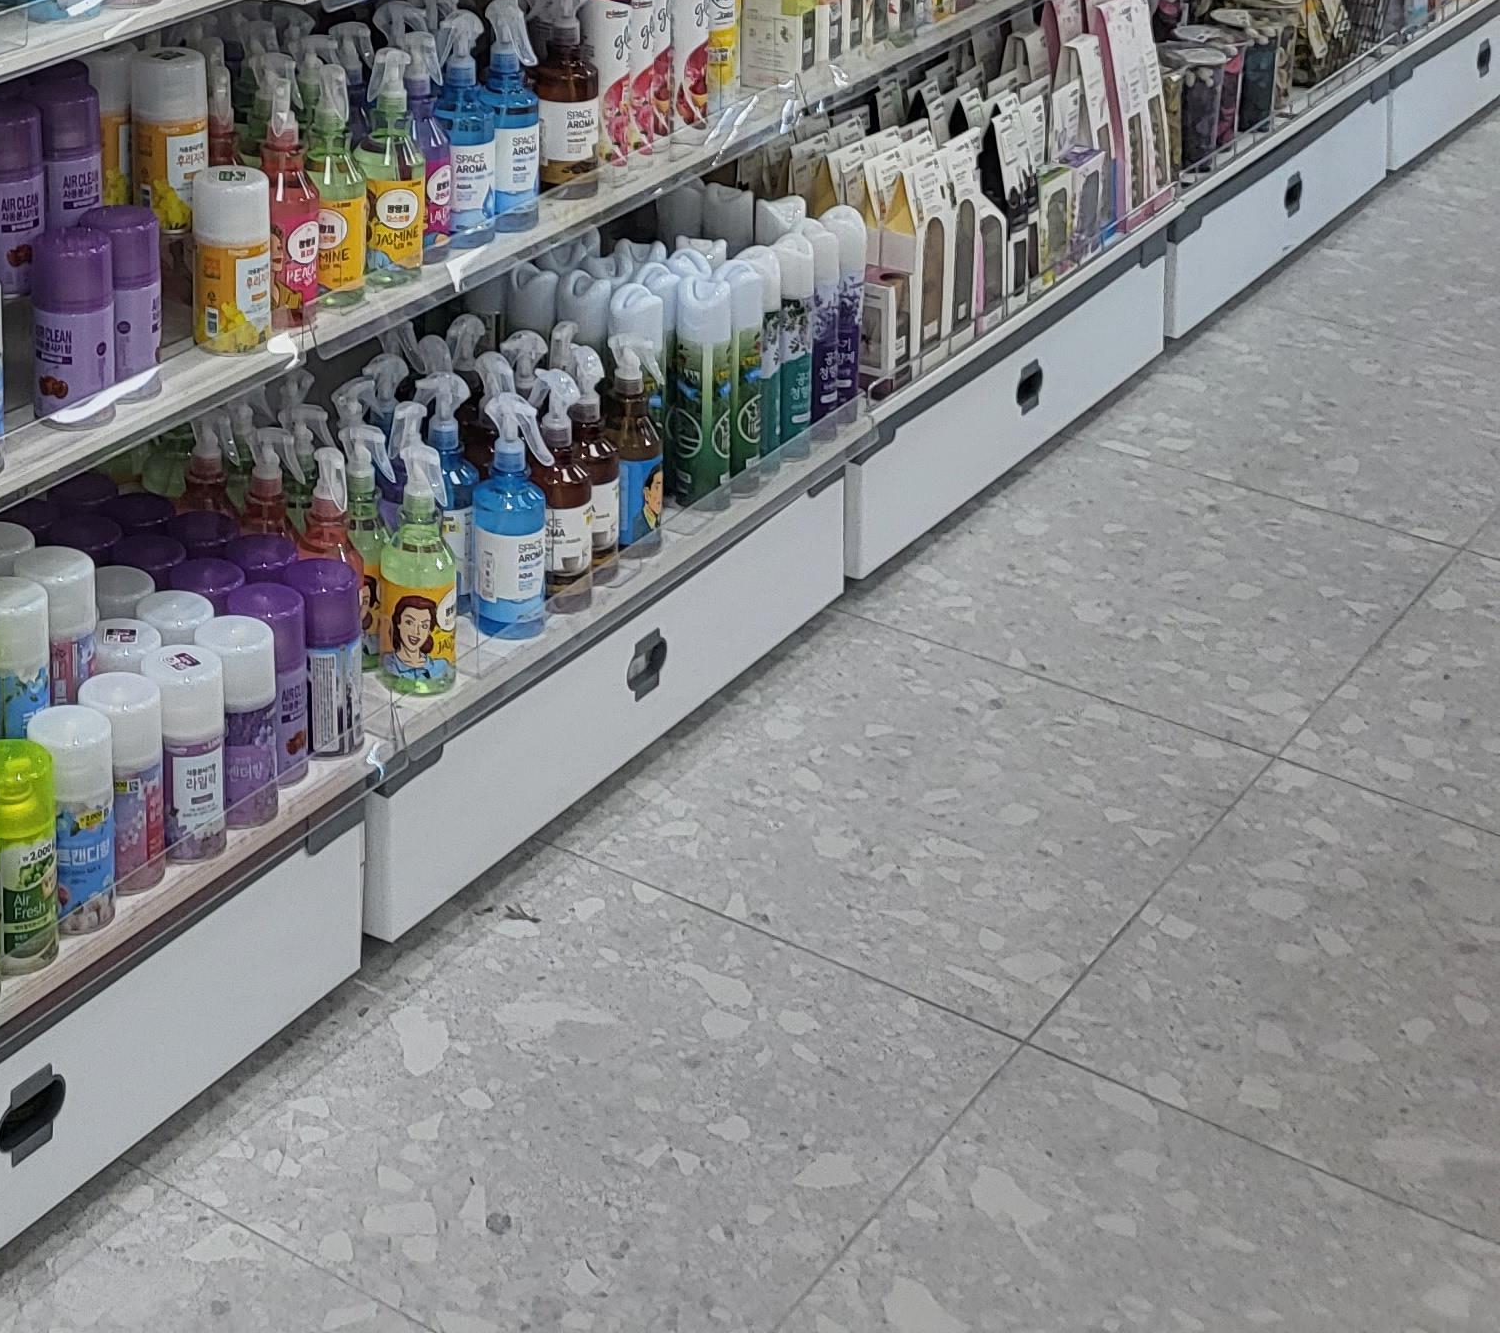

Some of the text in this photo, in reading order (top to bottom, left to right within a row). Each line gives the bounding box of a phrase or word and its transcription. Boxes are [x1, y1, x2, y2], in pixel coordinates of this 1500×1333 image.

[566, 110, 594, 121] SPACE
[566, 118, 595, 129] AROMA
[512, 135, 536, 147] SPACE
[512, 144, 538, 157] AROMA
[455, 153, 485, 165] SPACE
[455, 163, 488, 175] AROMA
[1, 193, 40, 212] AIR CLEAN
[376, 227, 420, 247] JASMINE
[517, 540, 543, 553] SPACE
[517, 551, 544, 563] AROMA
[13, 892, 32, 908] Air
[13, 900, 46, 919] Fresh
